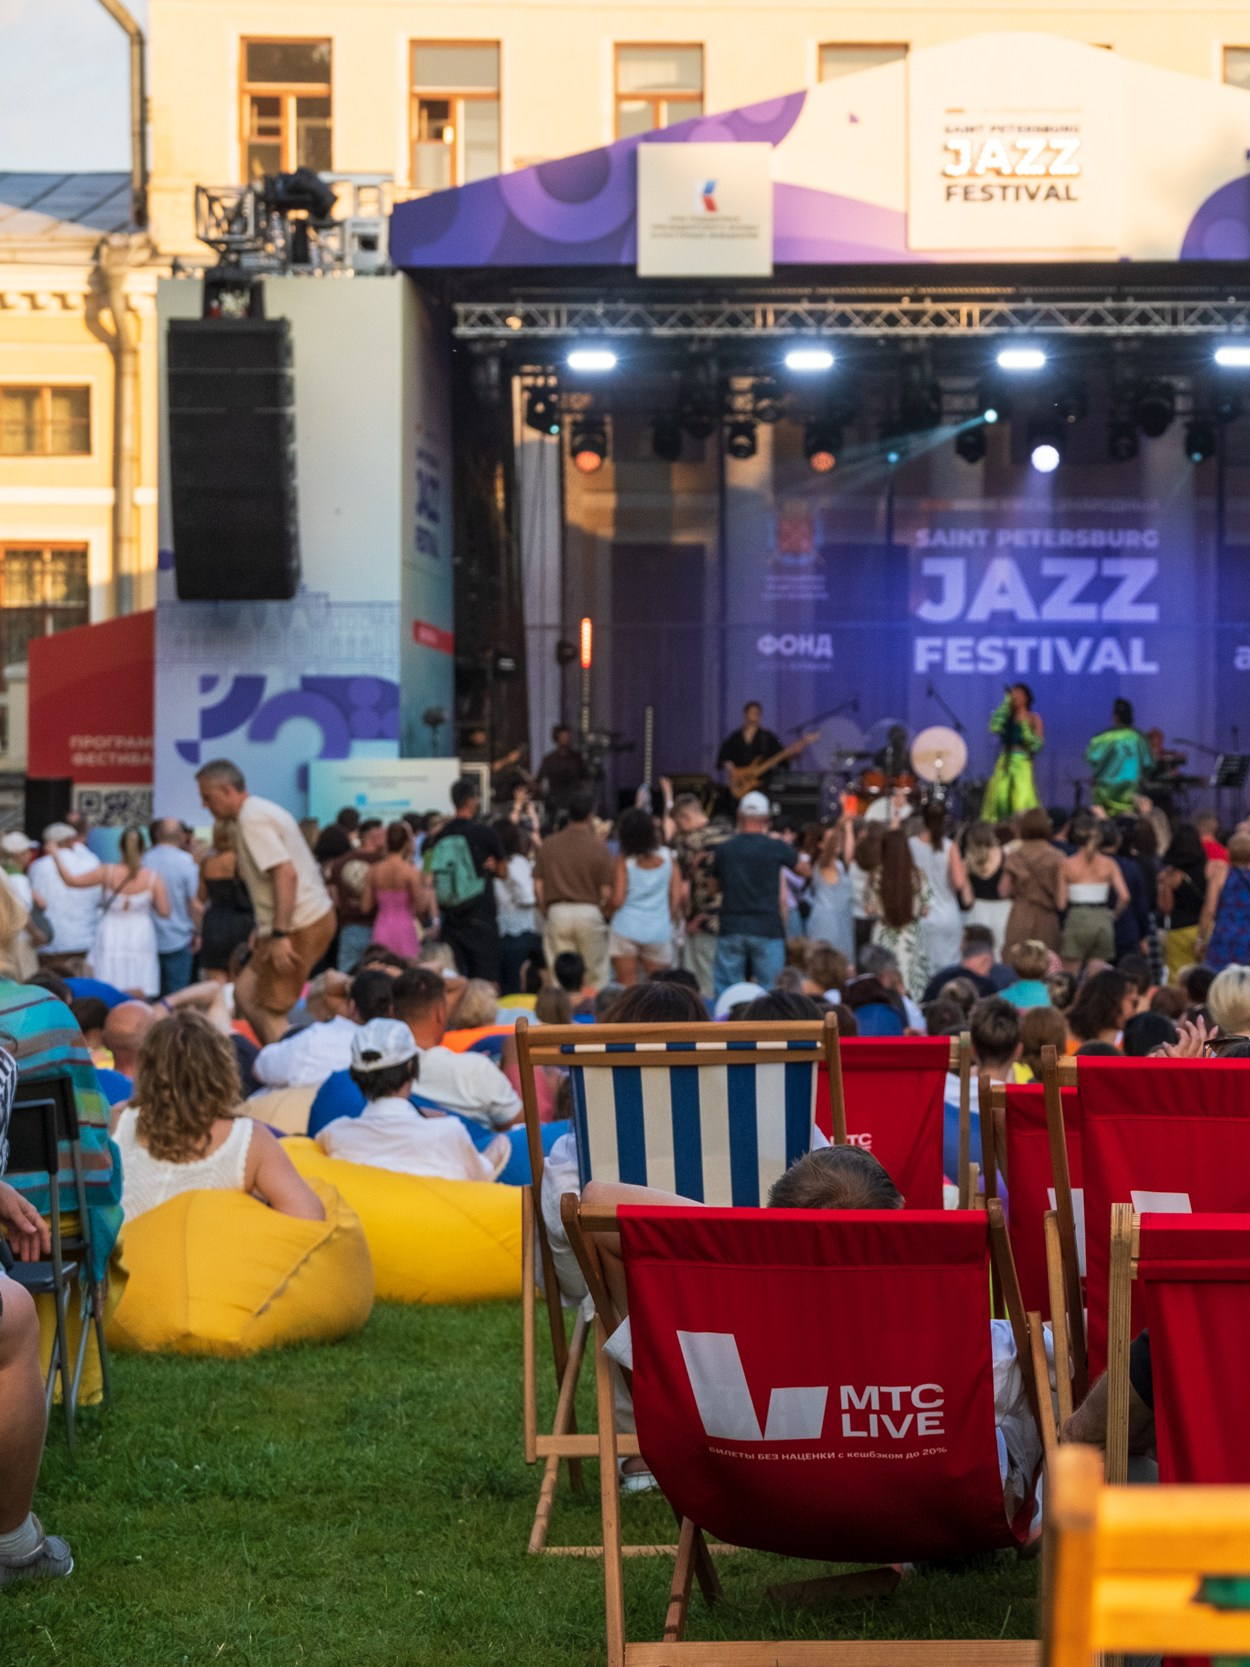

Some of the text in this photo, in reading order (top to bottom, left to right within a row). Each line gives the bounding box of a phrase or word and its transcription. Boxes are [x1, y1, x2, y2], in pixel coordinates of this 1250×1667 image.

[942, 138, 1080, 177] JAZZ
[945, 184, 1078, 201] FESTIVAL
[915, 529, 1159, 548] SAINT PETERSBURG
[917, 557, 1158, 622] JAZZ
[757, 633, 834, 659] ФОНД
[914, 636, 1159, 674] FESTIVAL
[829, 1133, 872, 1147] ТС
[841, 1411, 945, 1439] LIVE
[708, 1446, 755, 1460] БИЛЕТЫ
[781, 1452, 836, 1461] НАЦЕНКИ
[847, 1450, 903, 1459] кешбэком
[905, 1451, 920, 1459] до
[922, 1446, 948, 1456] 20%
